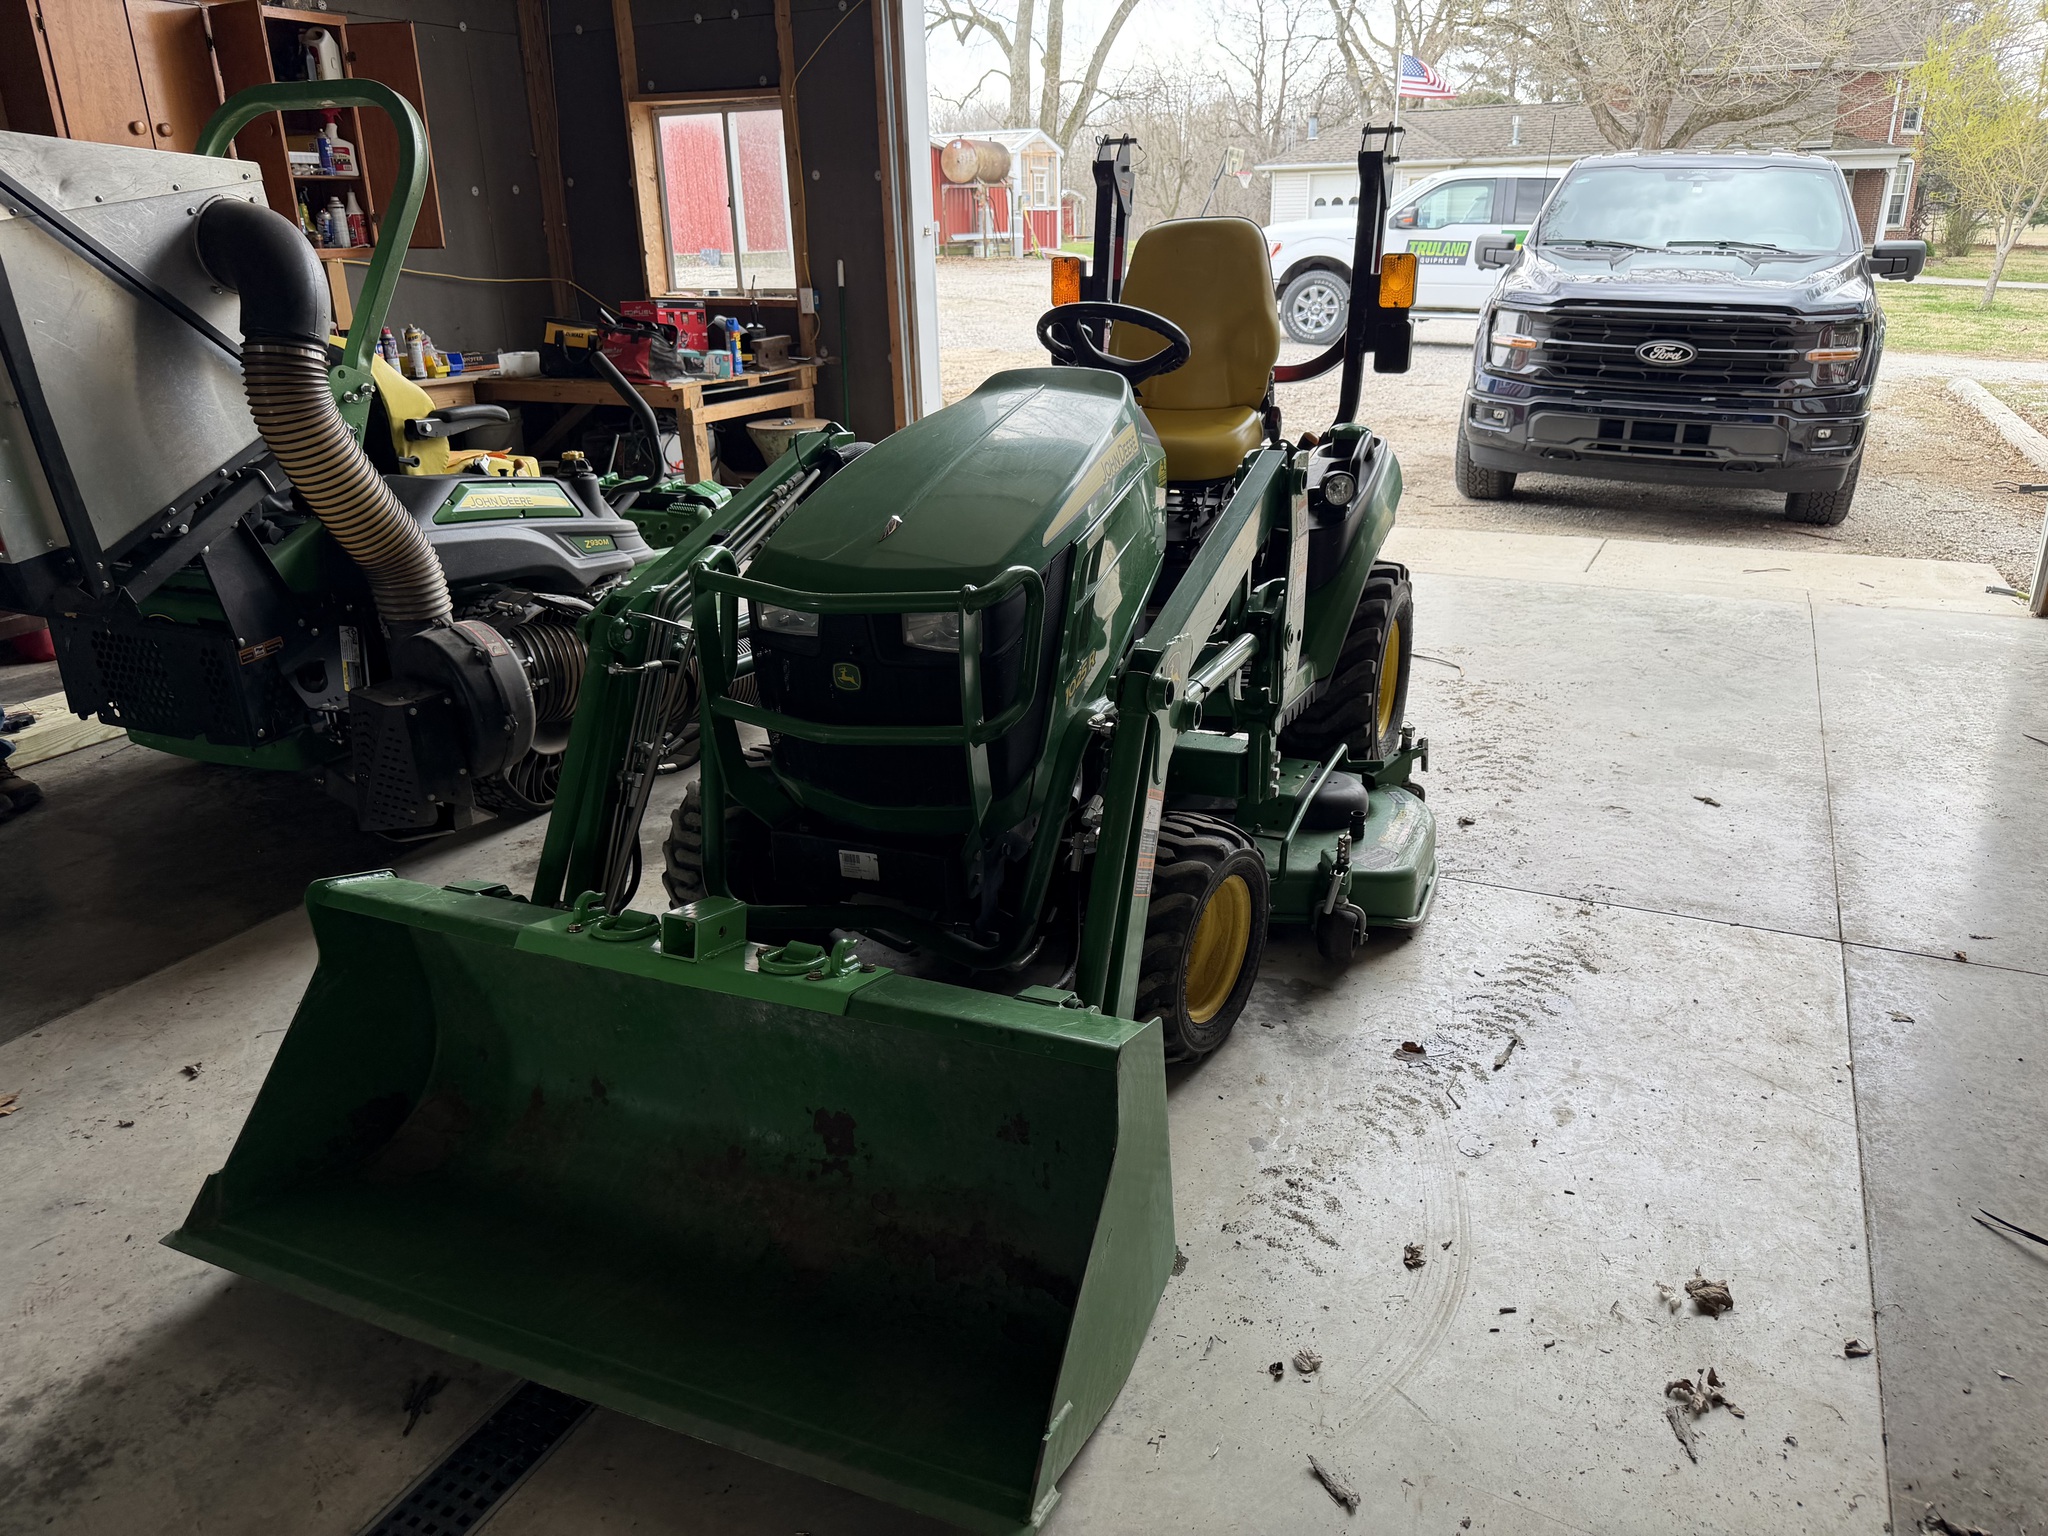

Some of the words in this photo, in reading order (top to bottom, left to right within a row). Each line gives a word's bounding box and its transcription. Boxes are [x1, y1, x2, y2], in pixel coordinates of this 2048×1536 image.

[1409, 240, 1469, 257] TRULAND
[1649, 345, 1684, 361] Ford
[1100, 453, 1120, 484] JOHN
[1117, 435, 1138, 463] DEERE
[470, 496, 499, 508] JOHN
[500, 495, 534, 506] DEERE
[584, 538, 610, 549] Z930M
